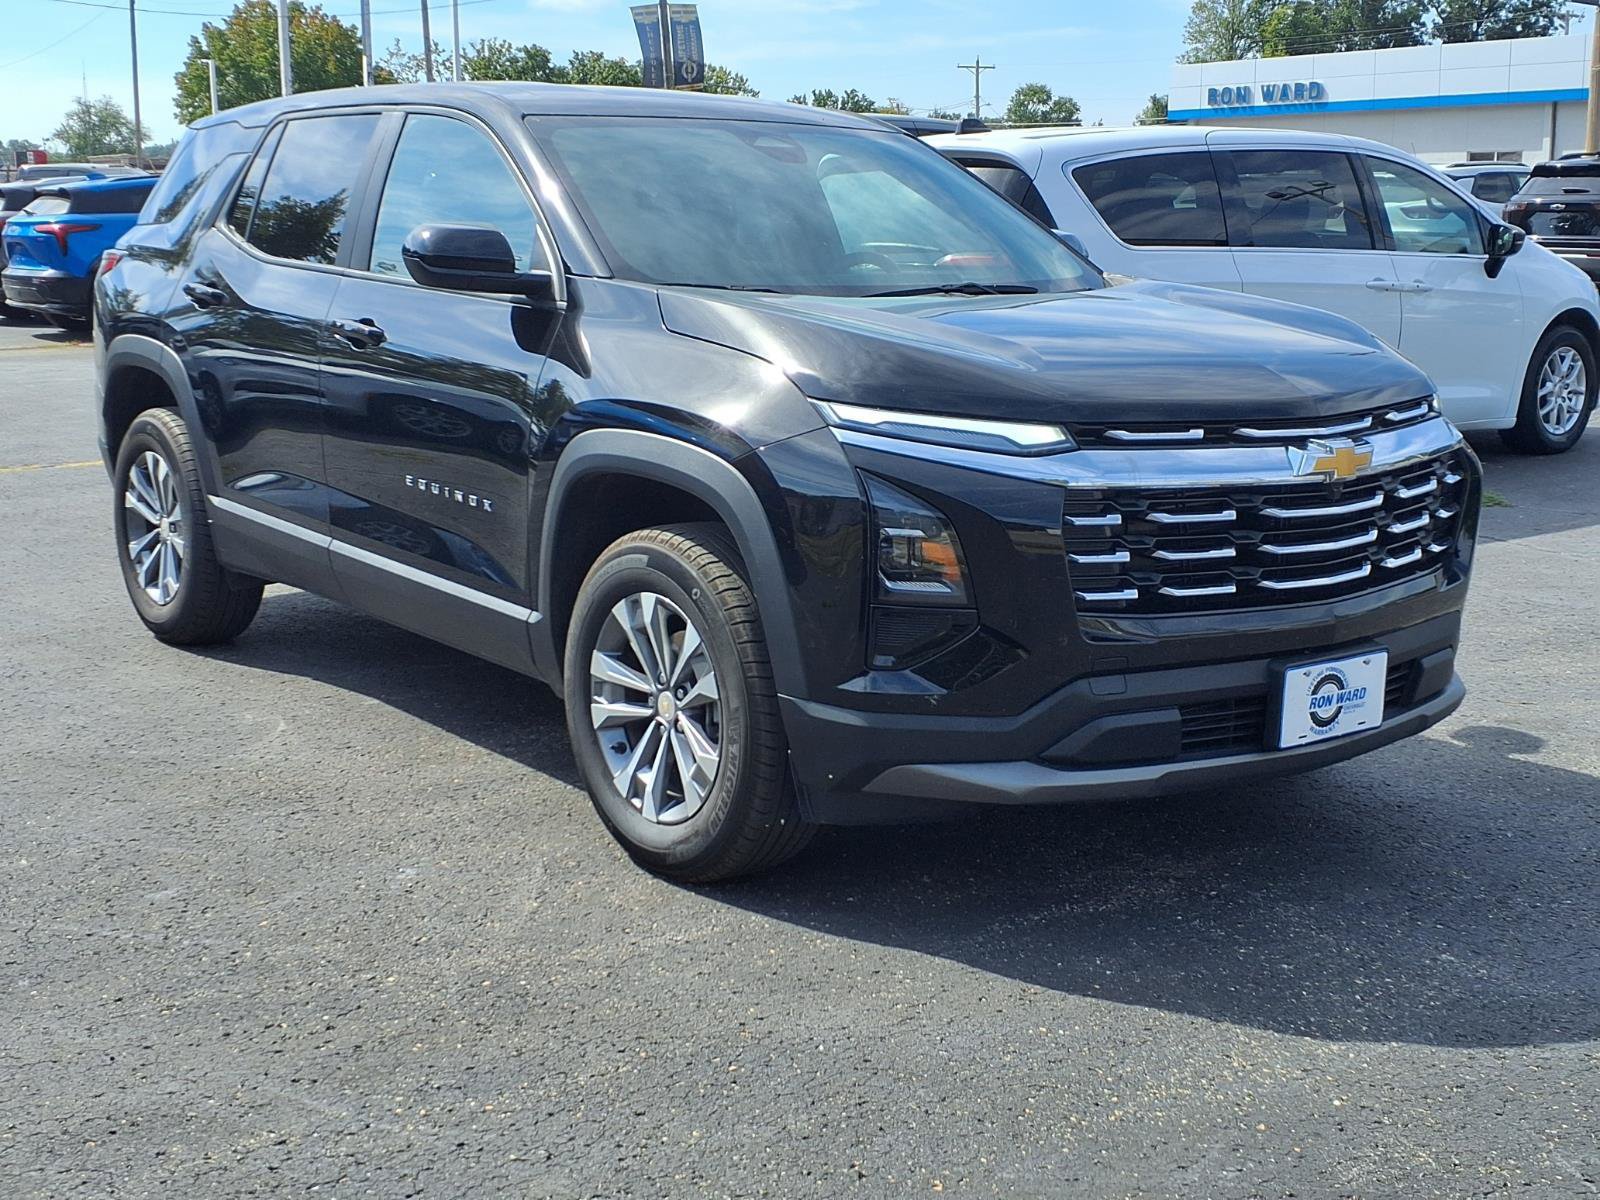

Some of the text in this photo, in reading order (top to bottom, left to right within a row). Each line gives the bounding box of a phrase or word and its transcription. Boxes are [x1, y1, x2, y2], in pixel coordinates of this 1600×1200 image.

[1207, 82, 1321, 105] RON WARD
[405, 475, 492, 512] EQUINOX
[1309, 693, 1334, 710] RON
[1336, 686, 1367, 704] WARD
[709, 752, 738, 835] MICHELIN
